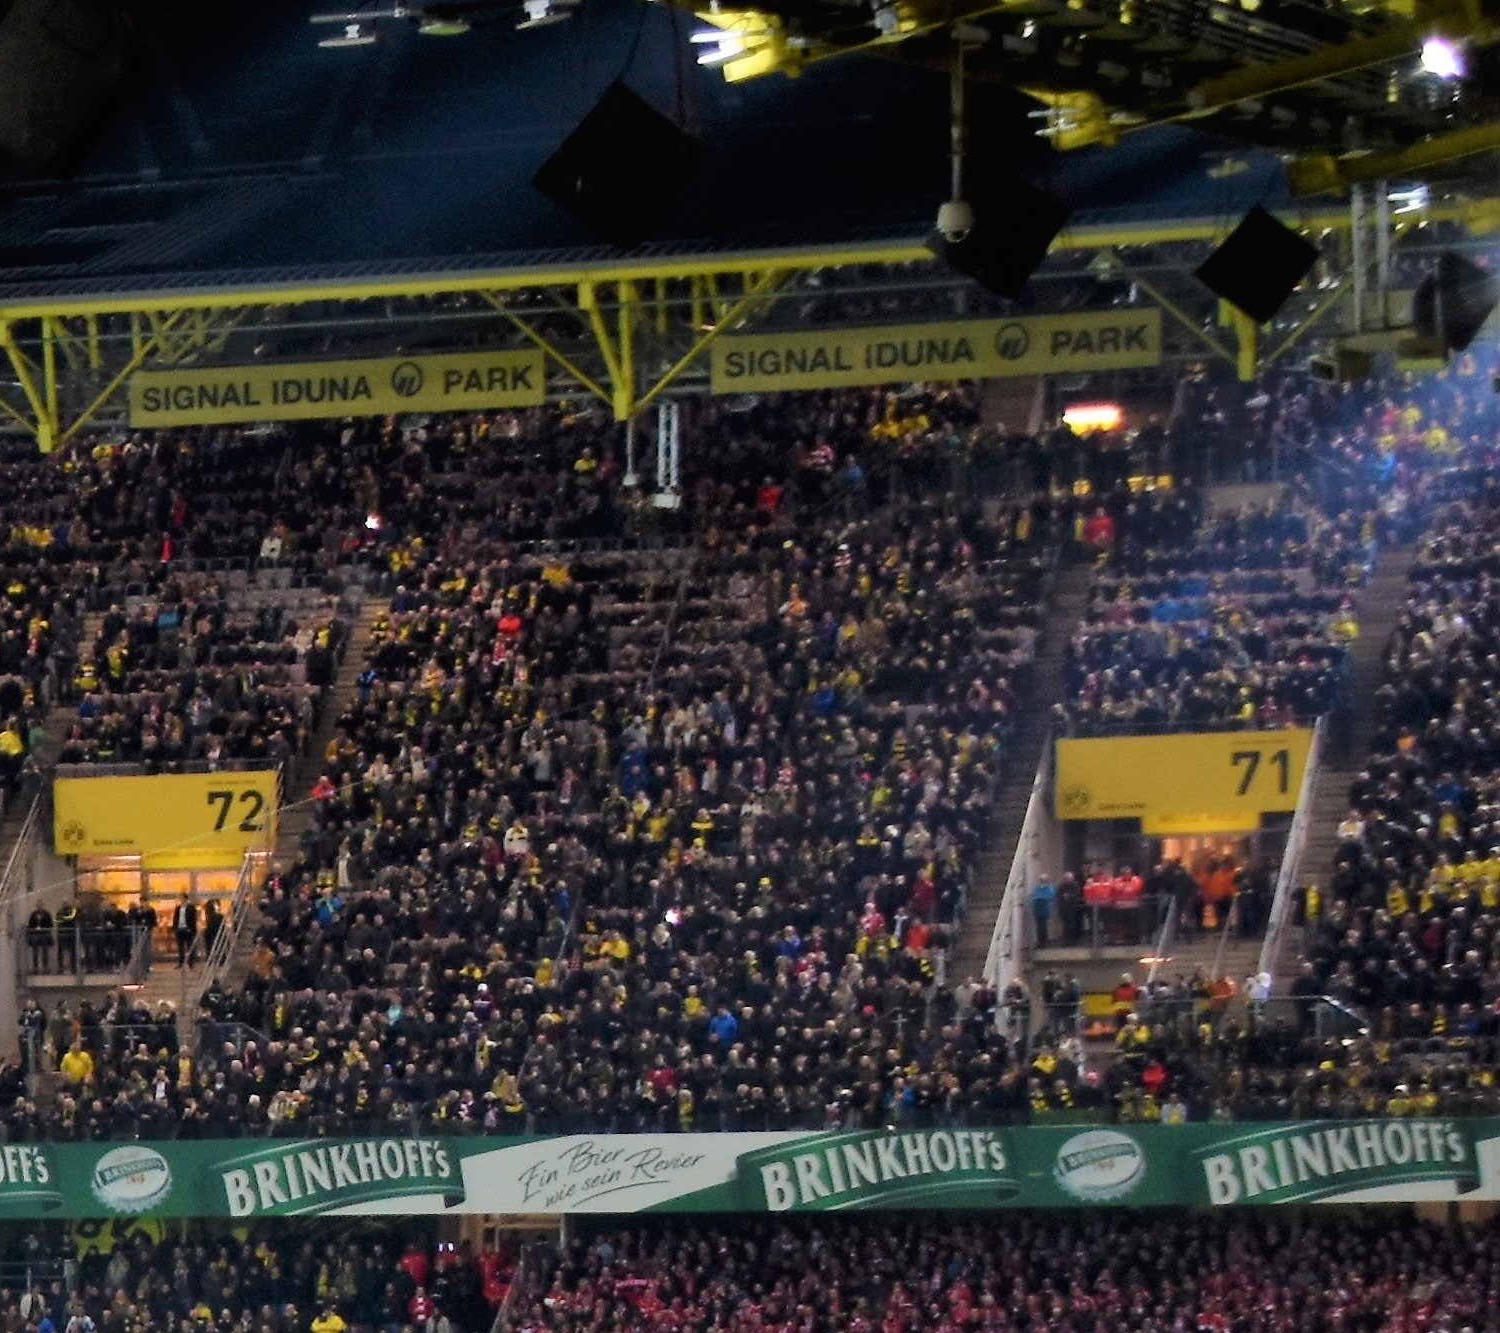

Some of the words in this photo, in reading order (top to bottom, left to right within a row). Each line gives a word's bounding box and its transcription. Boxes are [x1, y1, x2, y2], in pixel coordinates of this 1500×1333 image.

[725, 346, 852, 377] SIGNAL
[866, 338, 974, 368] IDUNA
[1049, 325, 1149, 355] PARK
[143, 383, 261, 412] SIGNAL
[273, 377, 372, 405] IDUNA
[444, 364, 533, 394] PARK
[1231, 748, 1291, 796] 71
[206, 791, 264, 833] 72
[518, 1160, 558, 1203] Ein
[558, 1141, 625, 1174] Bier
[624, 1147, 706, 1179] Revier
